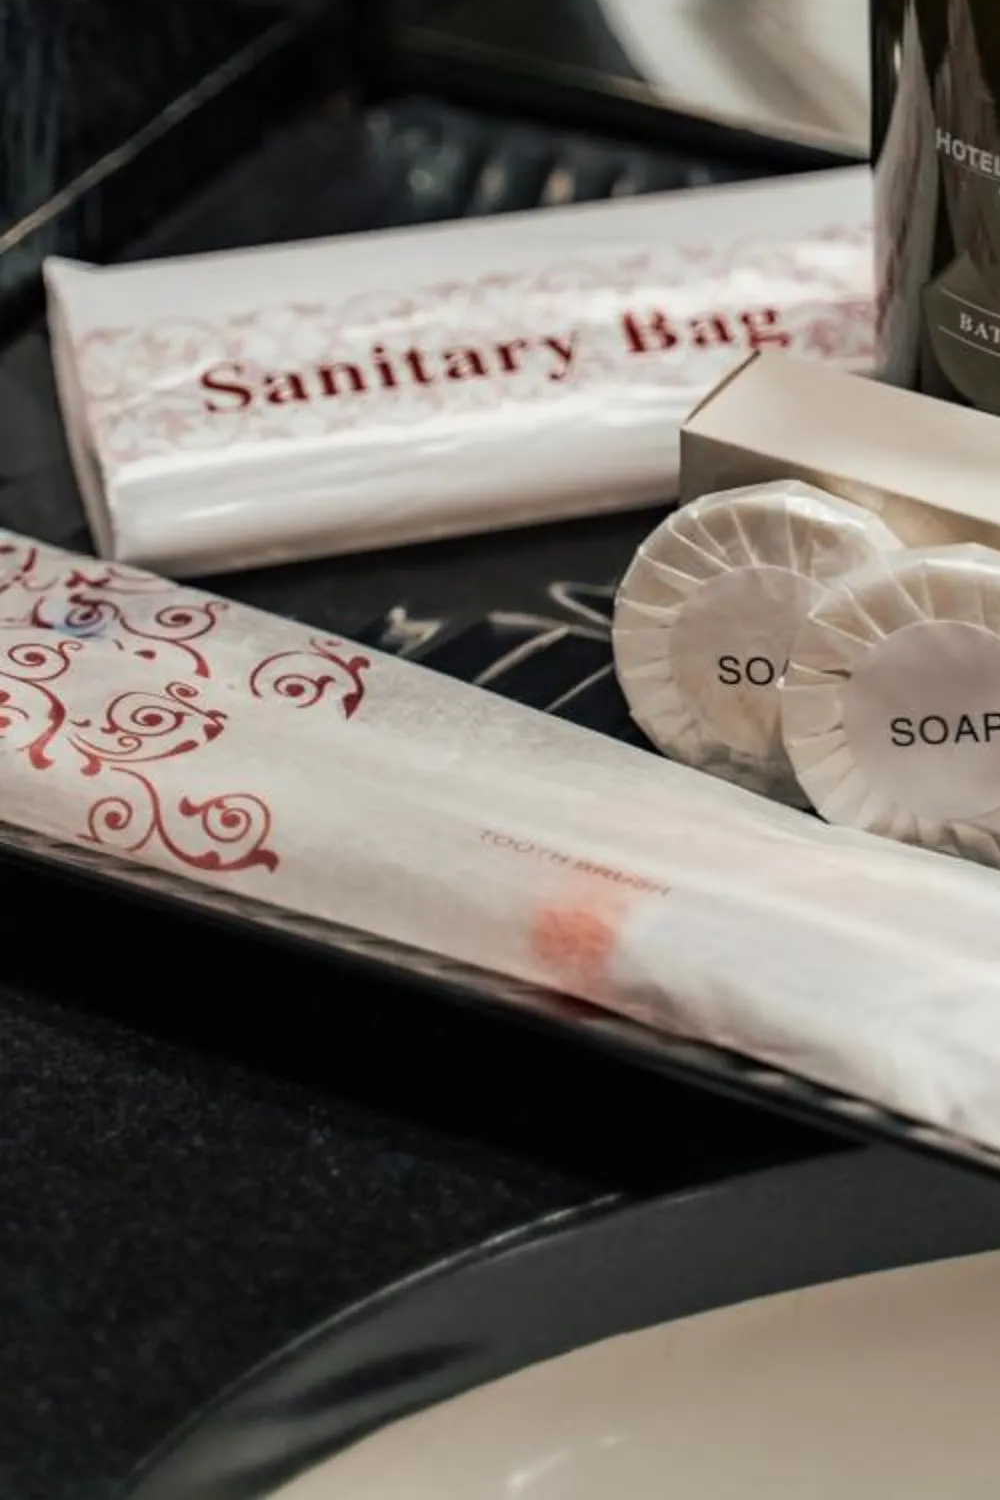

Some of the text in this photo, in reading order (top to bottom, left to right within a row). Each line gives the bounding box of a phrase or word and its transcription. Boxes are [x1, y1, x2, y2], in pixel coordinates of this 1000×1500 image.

[199, 305, 791, 415] Sanitary Bag
[718, 655, 790, 686] SO
